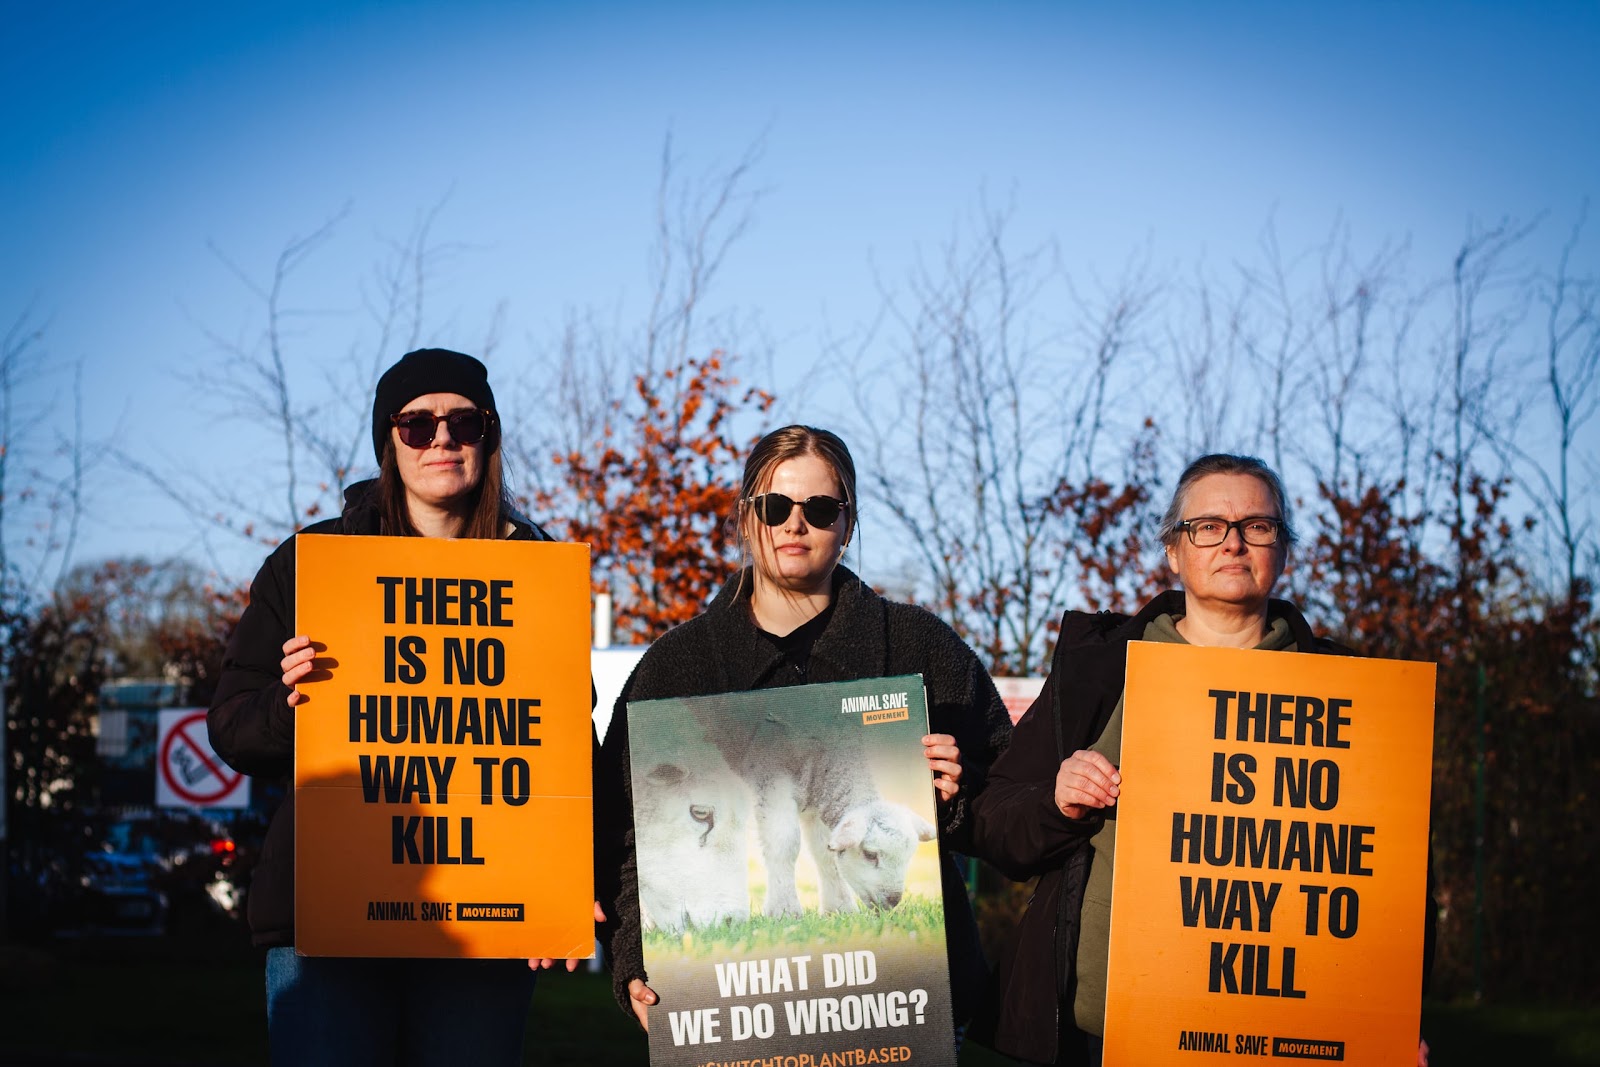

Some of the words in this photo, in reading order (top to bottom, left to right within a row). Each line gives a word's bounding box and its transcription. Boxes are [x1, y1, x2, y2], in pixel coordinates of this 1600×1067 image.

[376, 577, 513, 627] THERE
[385, 636, 427, 685] IS
[444, 638, 505, 687] NO
[349, 695, 541, 746] HUMANE
[842, 695, 882, 713] ANIMAL
[882, 692, 909, 710] SAVE
[865, 710, 906, 722] MOVEMENT
[1208, 689, 1353, 749] THERE
[359, 754, 456, 804] WAY
[474, 757, 530, 806] TO
[1211, 753, 1257, 805] IS
[1273, 757, 1340, 811] NO
[392, 816, 485, 865] KILL
[1170, 812, 1375, 877] HUMANE
[367, 902, 417, 921] ANIMAL
[421, 902, 452, 922] SAVE
[462, 907, 519, 918] MOVEMENT
[1179, 876, 1282, 933] WAY
[1299, 885, 1359, 939] TO
[715, 956, 812, 998] WHAT
[823, 950, 877, 989] DID
[1208, 942, 1307, 999] KILL
[669, 1009, 722, 1047] WE
[731, 1003, 775, 1041] DO
[784, 989, 929, 1037] WRONG?
[1178, 1030, 1231, 1054] ANIMAL
[1235, 1034, 1269, 1056] SAVE
[1278, 1042, 1339, 1057] MOVEMENT
